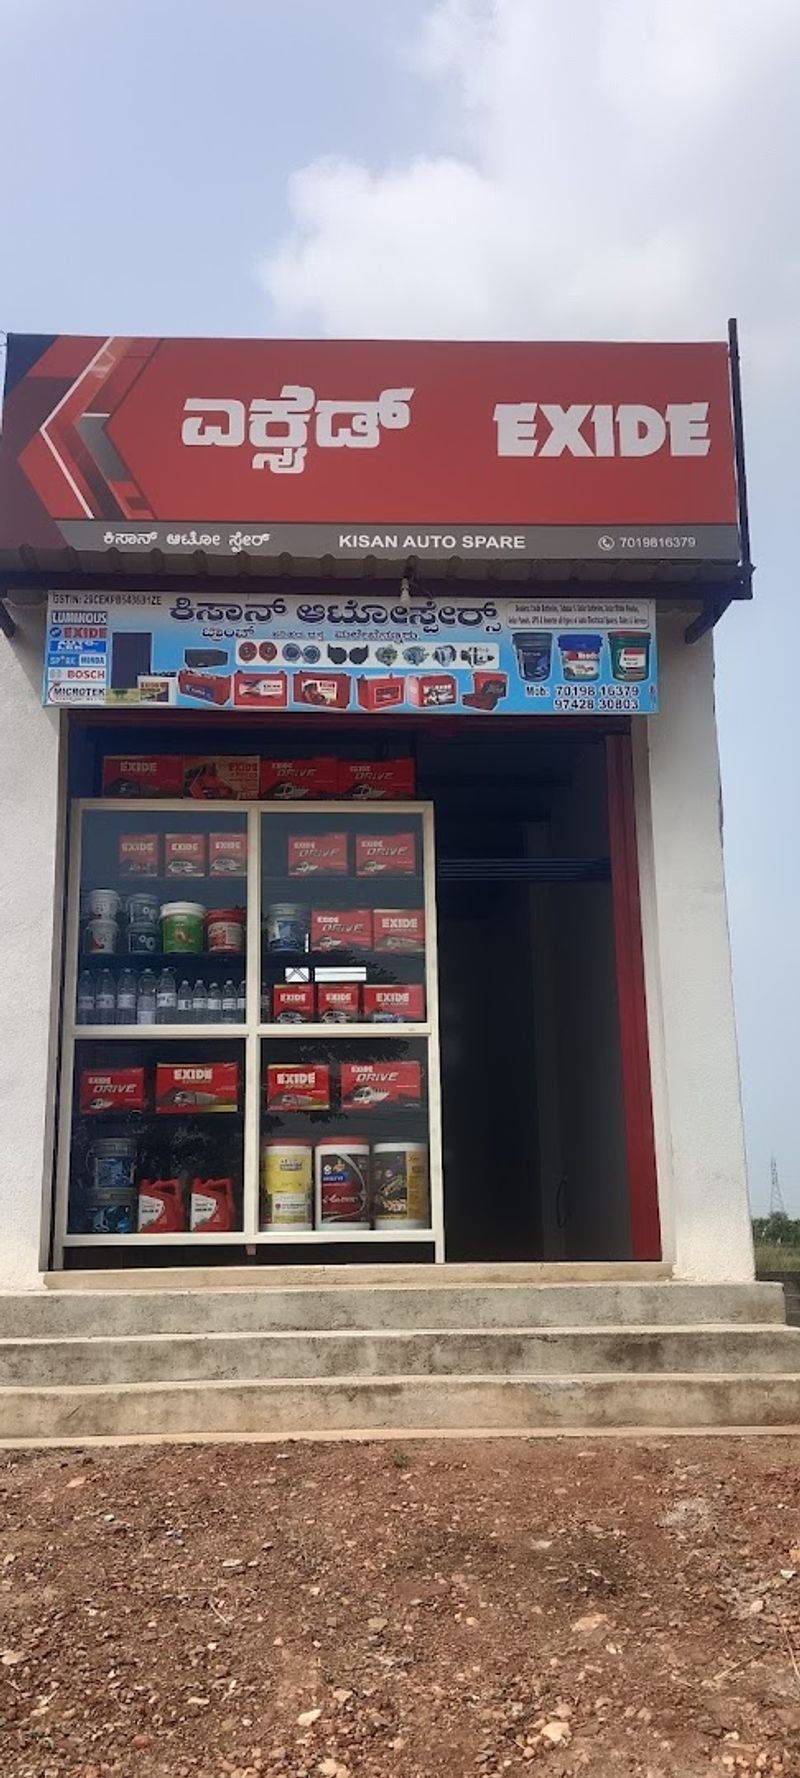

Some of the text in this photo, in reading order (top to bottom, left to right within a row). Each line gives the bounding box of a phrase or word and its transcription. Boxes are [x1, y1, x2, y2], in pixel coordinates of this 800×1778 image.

[493, 402, 711, 457] EXIDE
[103, 531, 158, 545] ಕಿಸಾನ್
[166, 530, 221, 546] ಆಟೋ
[339, 535, 526, 549] KISAN AUTO SPARE
[619, 537, 696, 548] 7019816379
[169, 597, 287, 622] ಕಿಸಾನ್
[52, 612, 107, 624] LUMINOUS
[64, 627, 108, 639] EXIDE
[67, 670, 105, 680] BOSCH
[54, 687, 105, 696] MICROTEK
[556, 686, 595, 697] 70198
[600, 686, 639, 697] 16379
[554, 700, 639, 710] 97428 30803
[120, 762, 158, 772] EXIDE
[381, 918, 418, 928] EXIDE
[280, 993, 306, 1002] EXIDE
[325, 993, 352, 1002] EXIDE
[375, 992, 410, 1002] EXIDE
[173, 1068, 214, 1081] EXIDE
[276, 1072, 316, 1085] EXIDE
[356, 1072, 400, 1082] DRIVE
[92, 1083, 138, 1094] DRIVE
